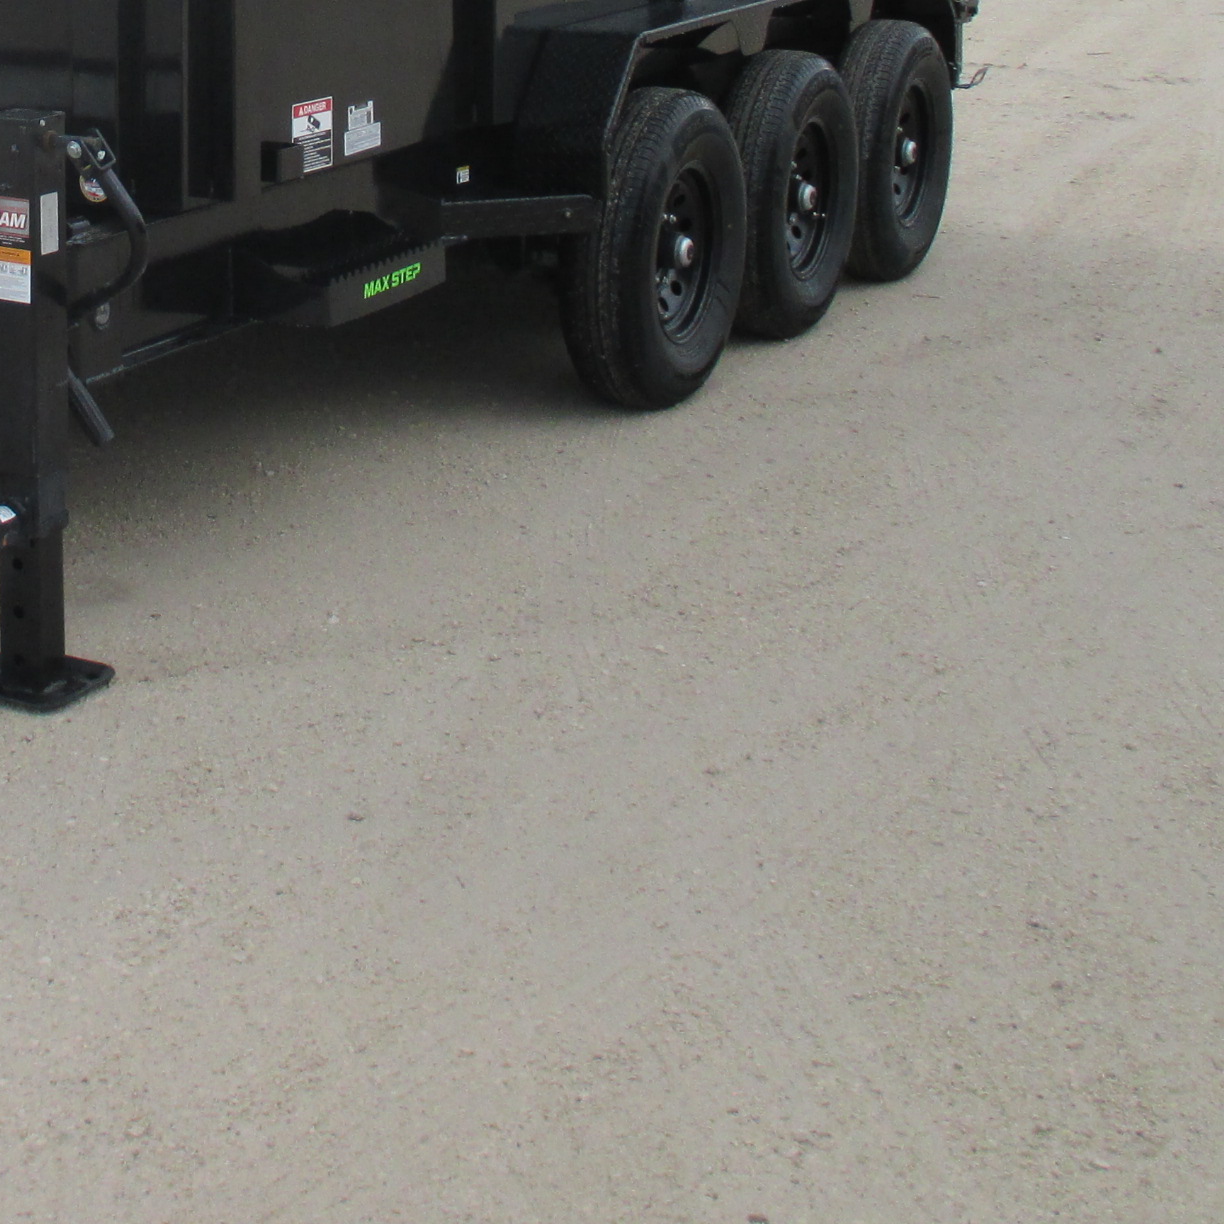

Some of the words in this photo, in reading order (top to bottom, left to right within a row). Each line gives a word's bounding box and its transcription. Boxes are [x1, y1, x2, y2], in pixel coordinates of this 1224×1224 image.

[303, 101, 327, 114] DANGER
[364, 274, 390, 299] MAX
[391, 262, 421, 288] STEP
